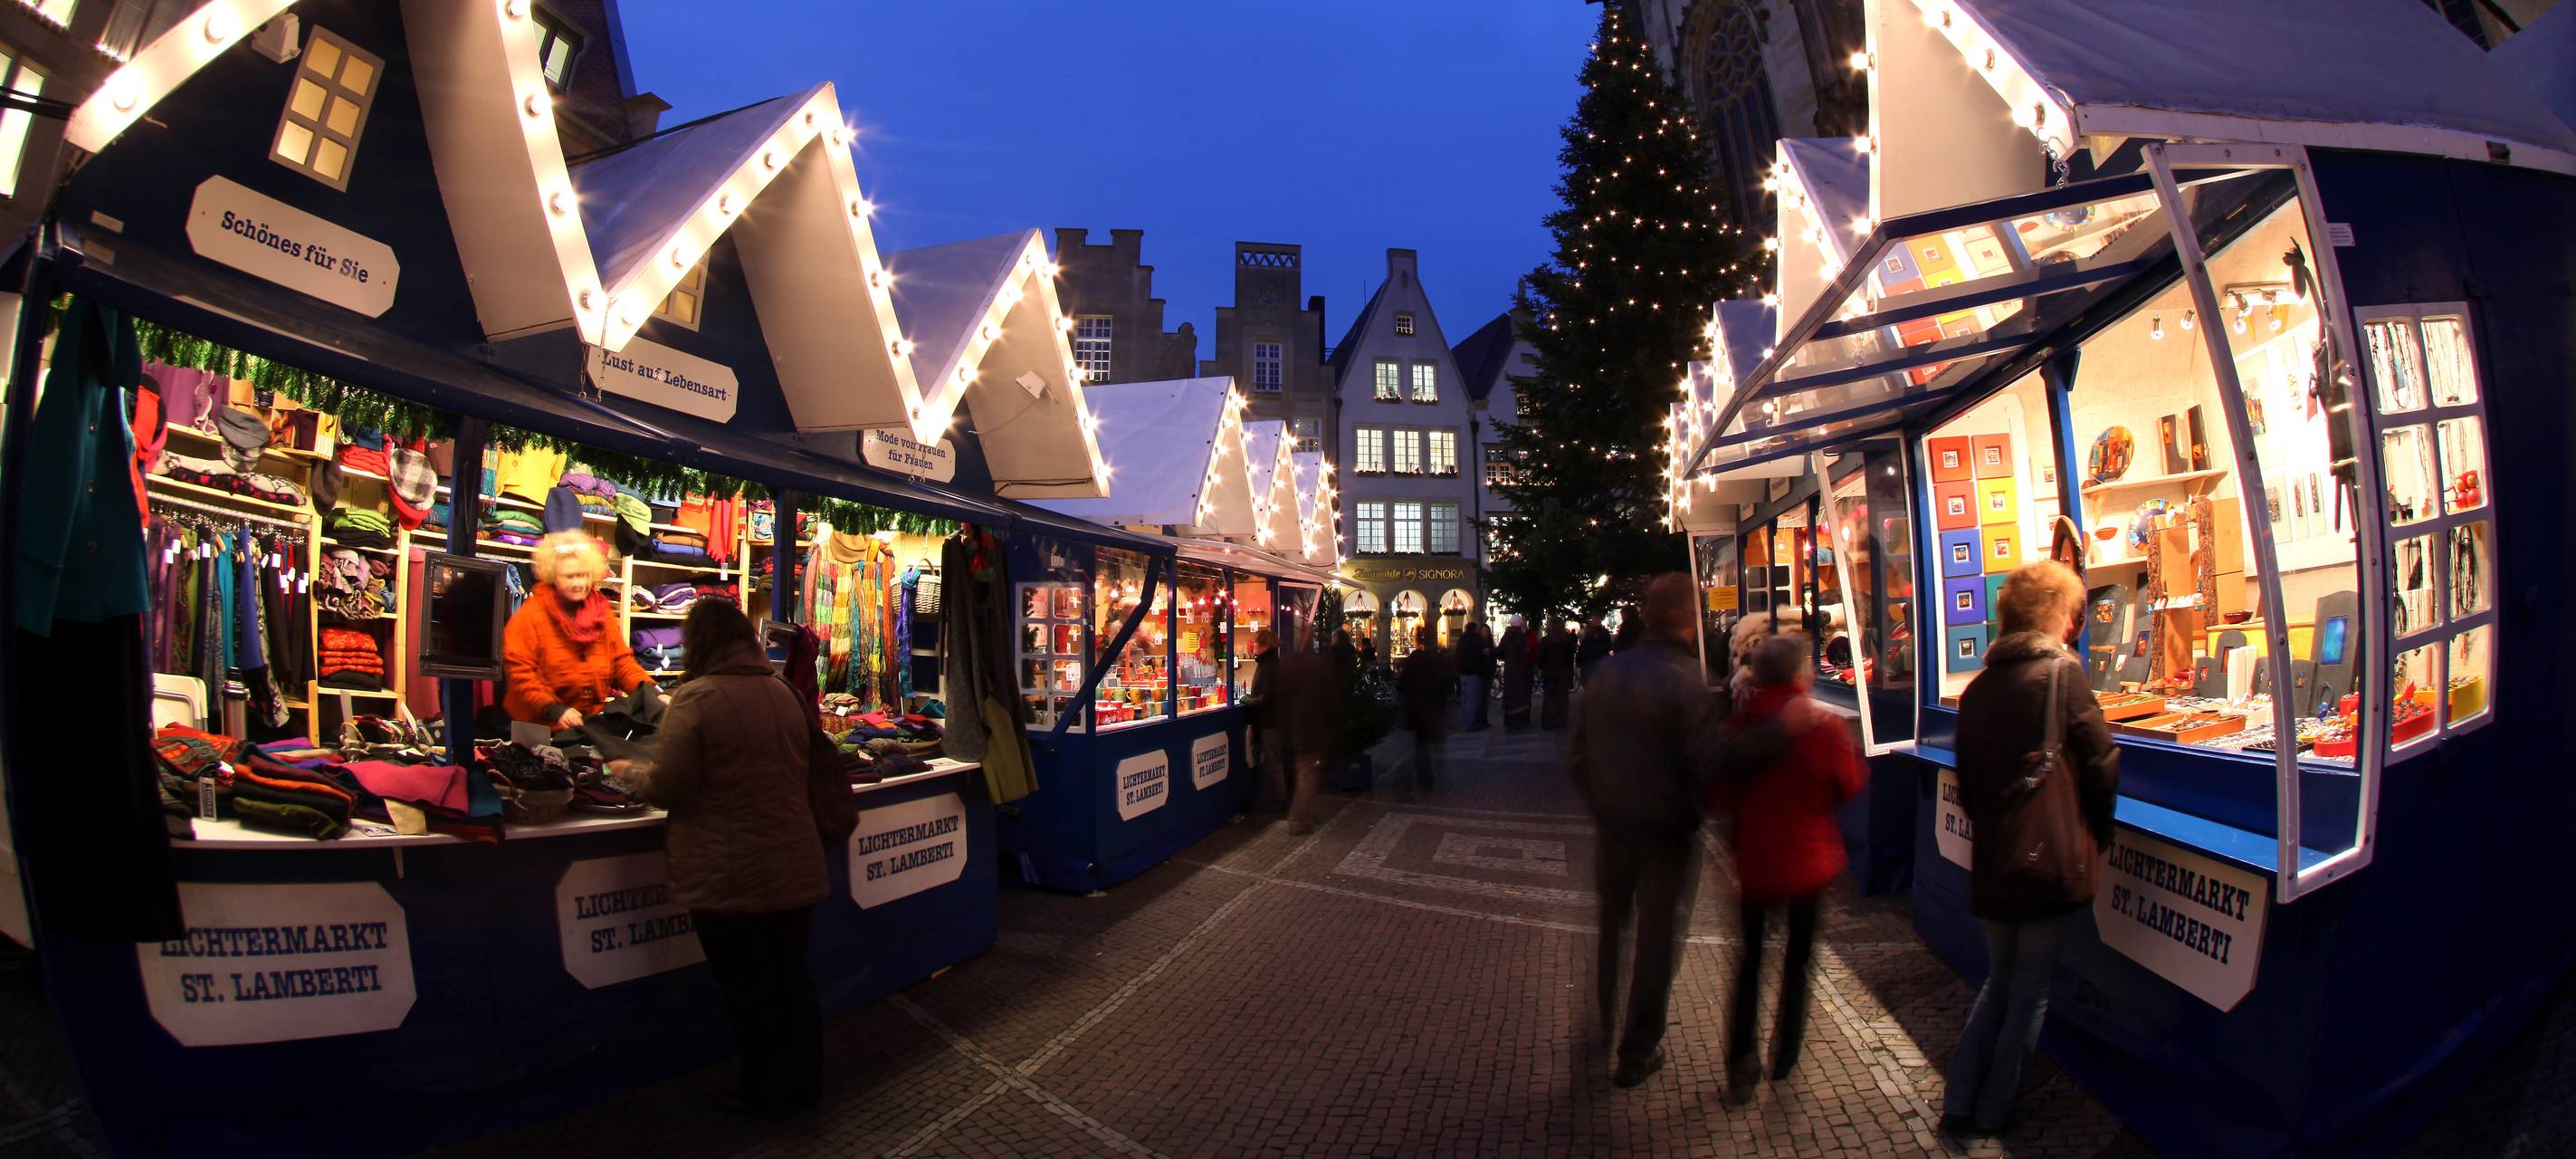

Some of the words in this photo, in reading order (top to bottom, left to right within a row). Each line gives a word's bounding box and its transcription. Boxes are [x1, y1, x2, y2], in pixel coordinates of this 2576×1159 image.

[221, 210, 302, 258] Schönes
[304, 244, 337, 271] für
[339, 257, 369, 283] Sie
[602, 350, 634, 373] Lust
[638, 364, 663, 381] auf
[664, 370, 727, 401] Lebensart
[876, 429, 899, 445] Mode
[901, 438, 916, 450] von
[888, 449, 902, 462] für
[904, 454, 933, 470] Frauen
[1418, 569, 1465, 580] SIGNORA
[1197, 744, 1227, 764] LICHTERMARKT
[1123, 764, 1166, 790] LICHTERMARKT
[1126, 791, 1136, 806] ST.
[1136, 781, 1163, 802] LAMBERTI
[858, 815, 959, 857] LICHTERMARKT
[1945, 812, 1957, 835] ST.
[866, 861, 887, 882] ST.
[890, 841, 954, 876] LAMBERTI
[2108, 841, 2250, 922] LICHTERMARKT
[2112, 884, 2132, 918] ST.
[2136, 896, 2232, 965] LAMBERTI
[591, 926, 623, 953] ST.
[181, 972, 224, 1003] ST.
[230, 964, 382, 1002] LAMBERTI
